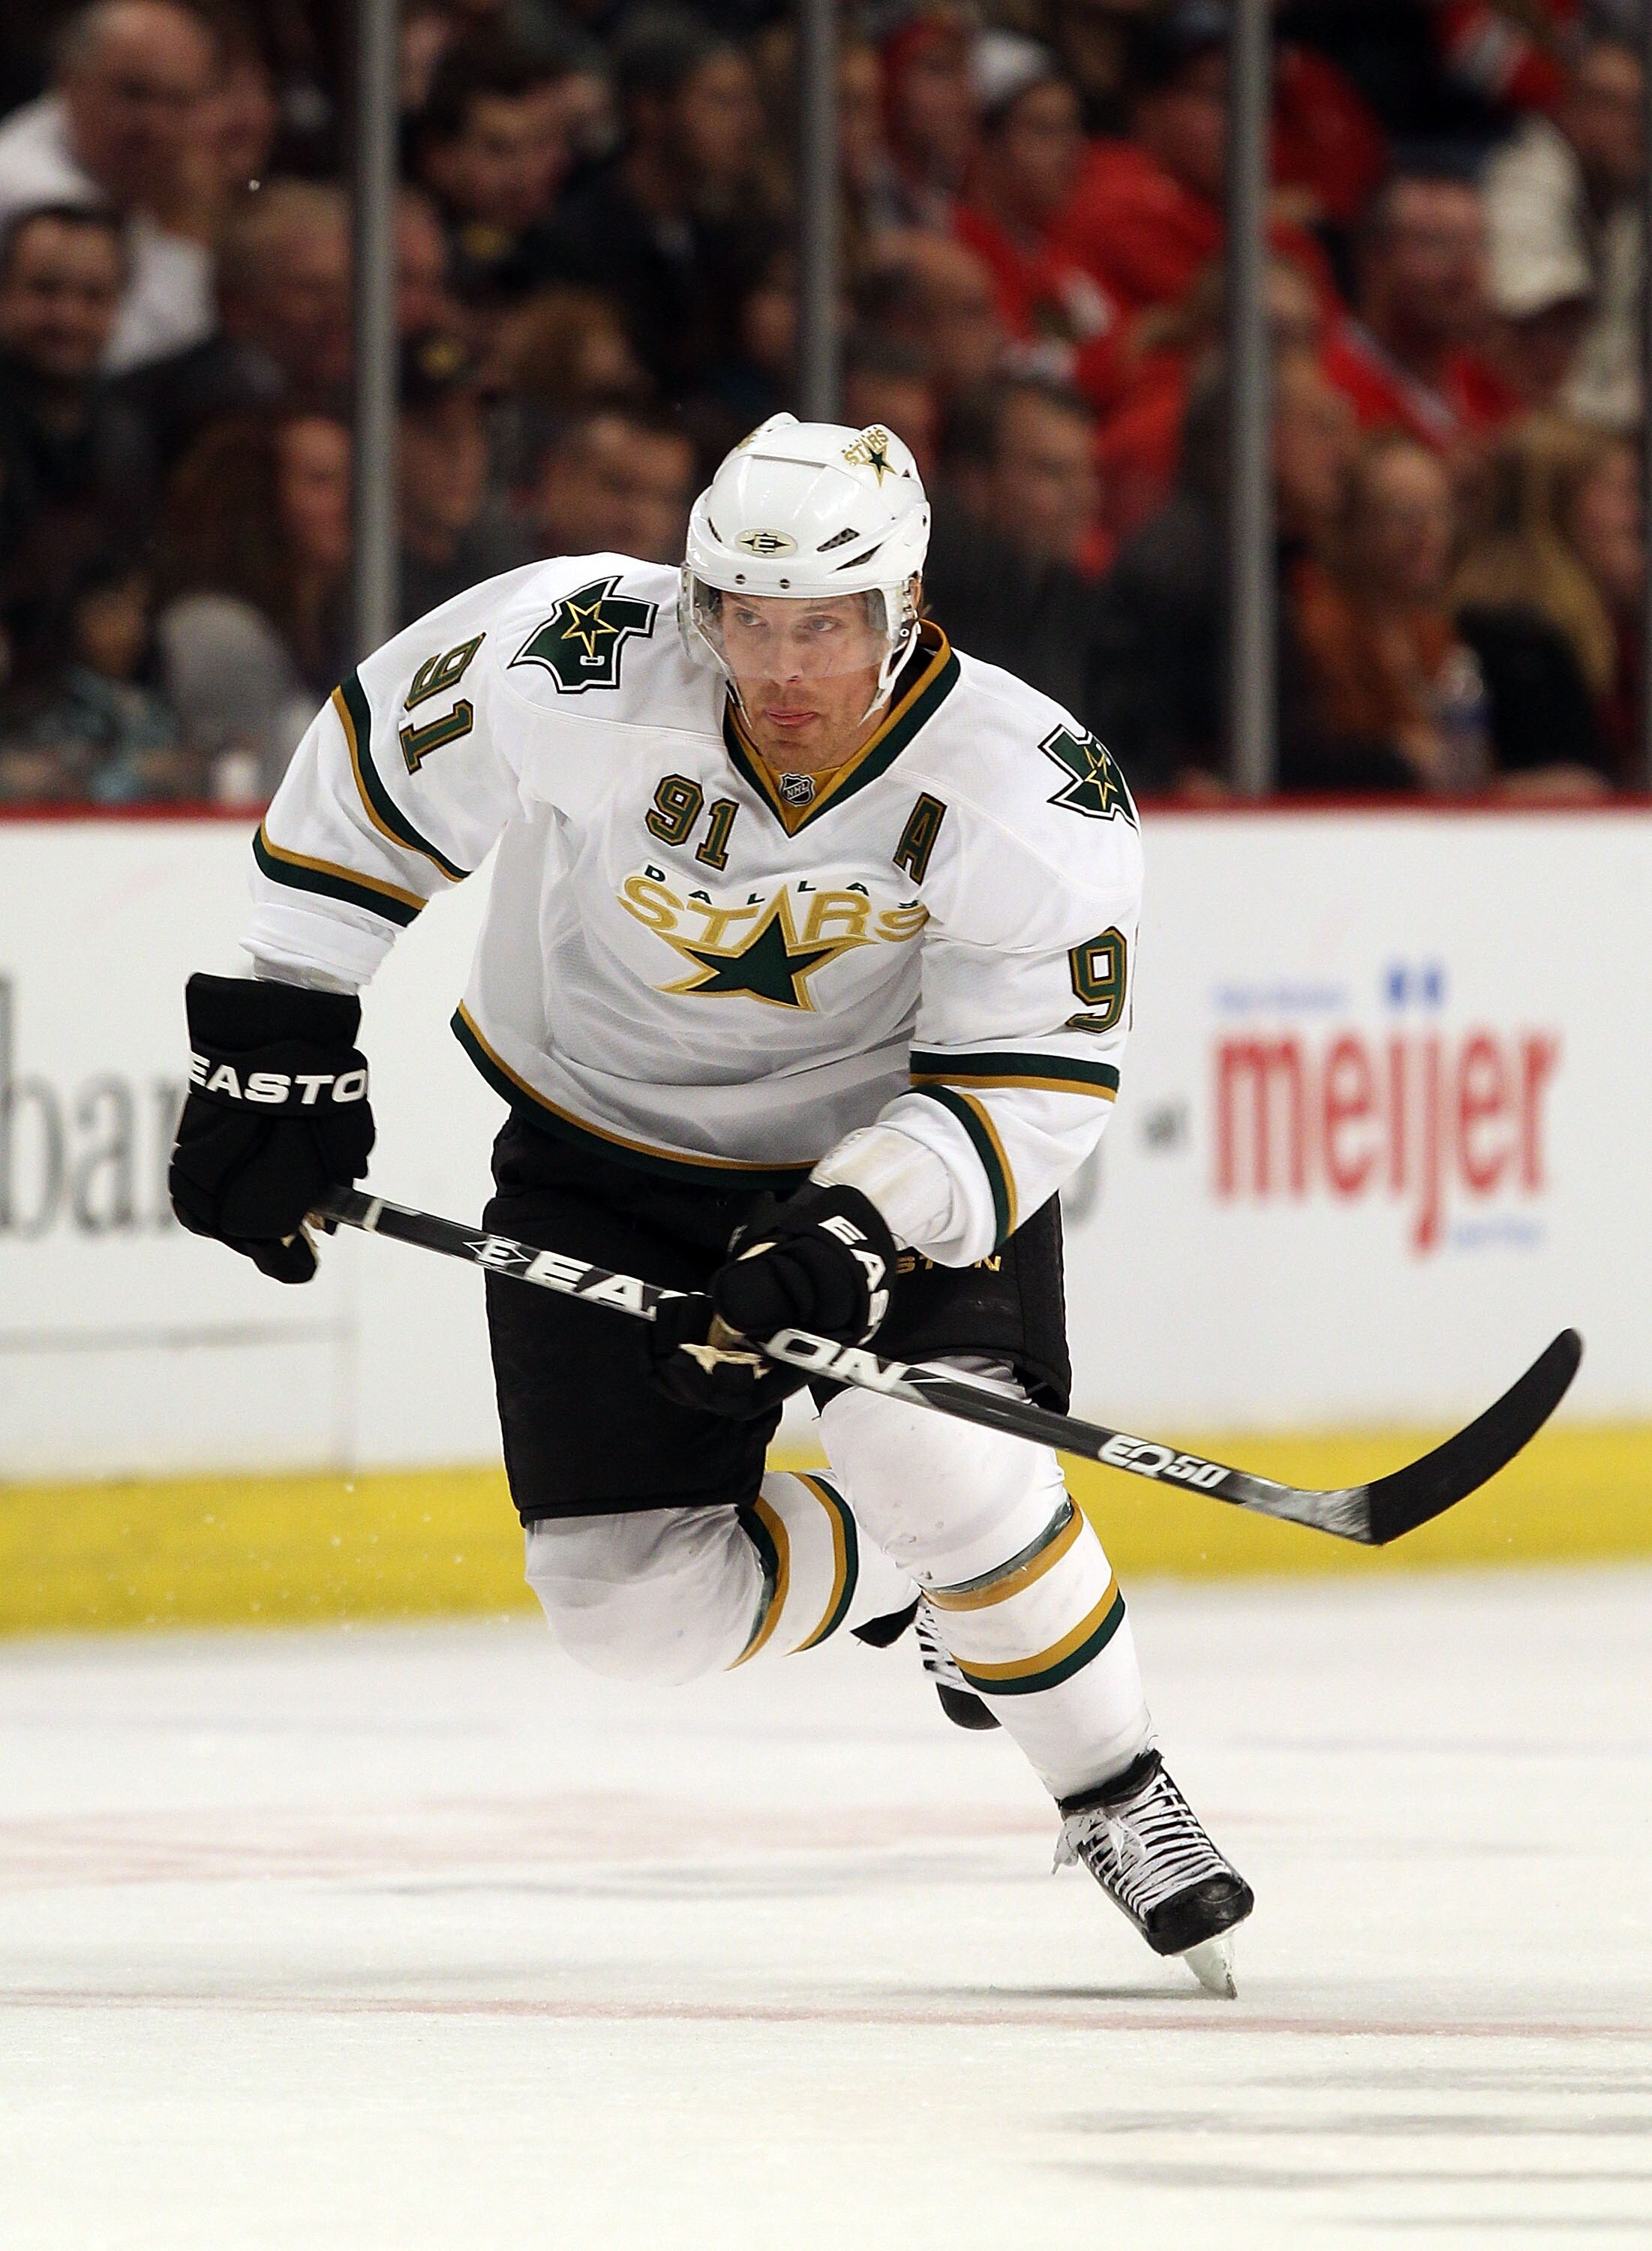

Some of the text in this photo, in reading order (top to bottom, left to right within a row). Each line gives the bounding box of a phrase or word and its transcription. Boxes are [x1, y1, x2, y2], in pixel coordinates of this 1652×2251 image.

[844, 429, 889, 466] STARS
[399, 633, 486, 774] 91
[645, 774, 740, 871] 91
[893, 792, 948, 886] A
[617, 875, 930, 953] STARS
[1065, 925, 1137, 1033] 9
[1213, 959, 1560, 1255] meijer
[1098, 1434, 1231, 1489] EQ50
